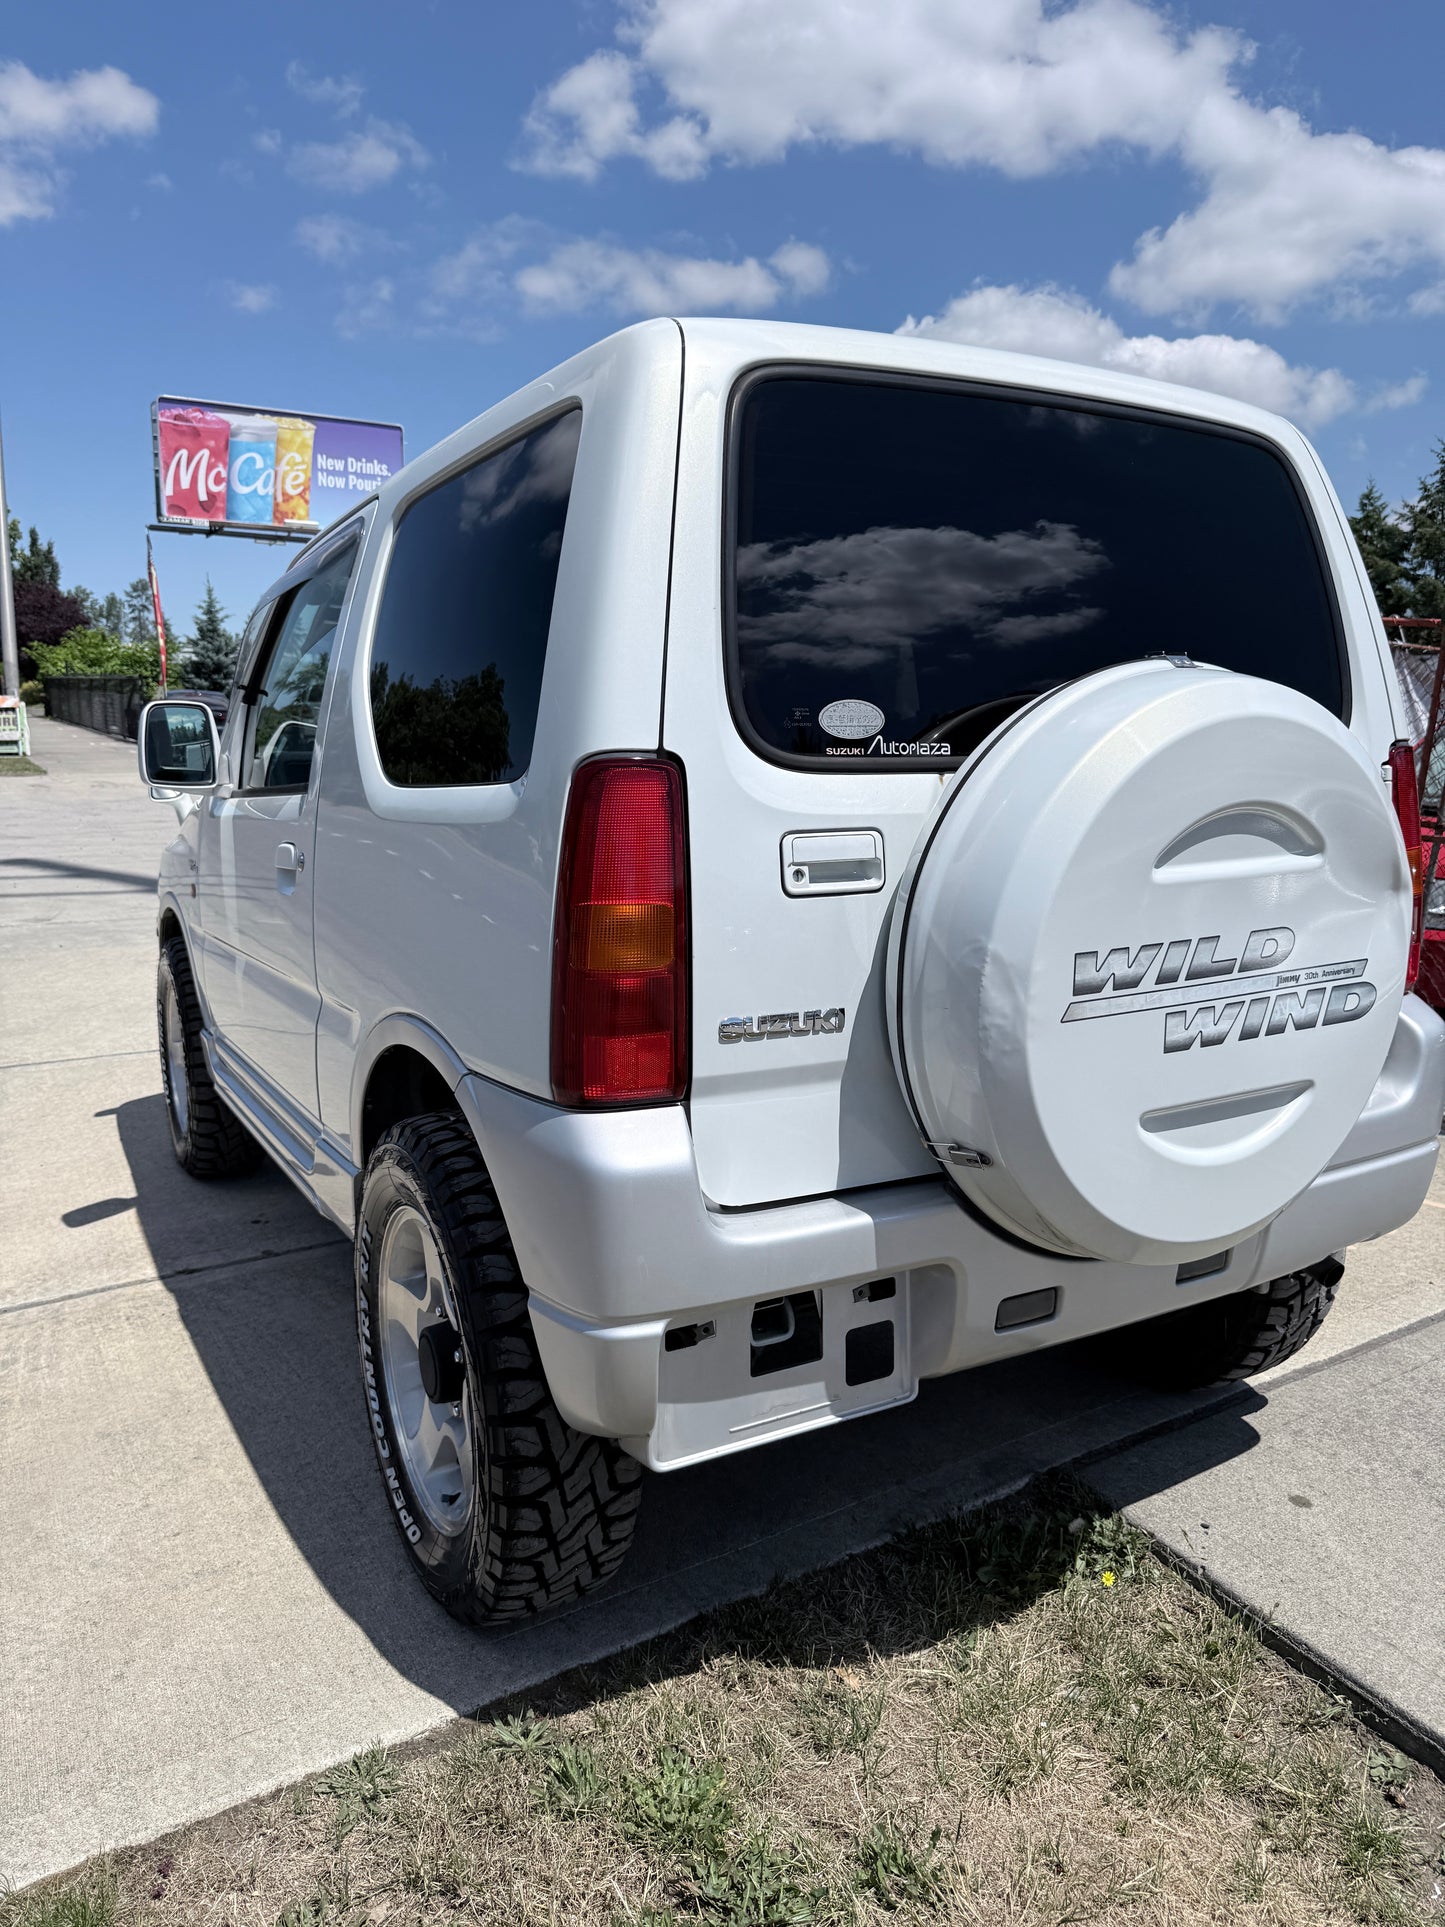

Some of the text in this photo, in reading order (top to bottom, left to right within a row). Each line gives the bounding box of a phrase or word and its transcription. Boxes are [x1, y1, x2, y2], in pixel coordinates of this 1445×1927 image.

[317, 453, 392, 477] New Drinks.
[317, 471, 346, 489] Now
[826, 747, 865, 755] SUZUKI
[1072, 926, 1296, 997] WILD
[1304, 972, 1320, 981] 30th
[1321, 967, 1356, 978] Anniversary
[718, 1008, 846, 1045] SUZUKI
[1163, 981, 1377, 1054] WIND
[359, 1219, 423, 1546] OPEN COUNTRY R/T
